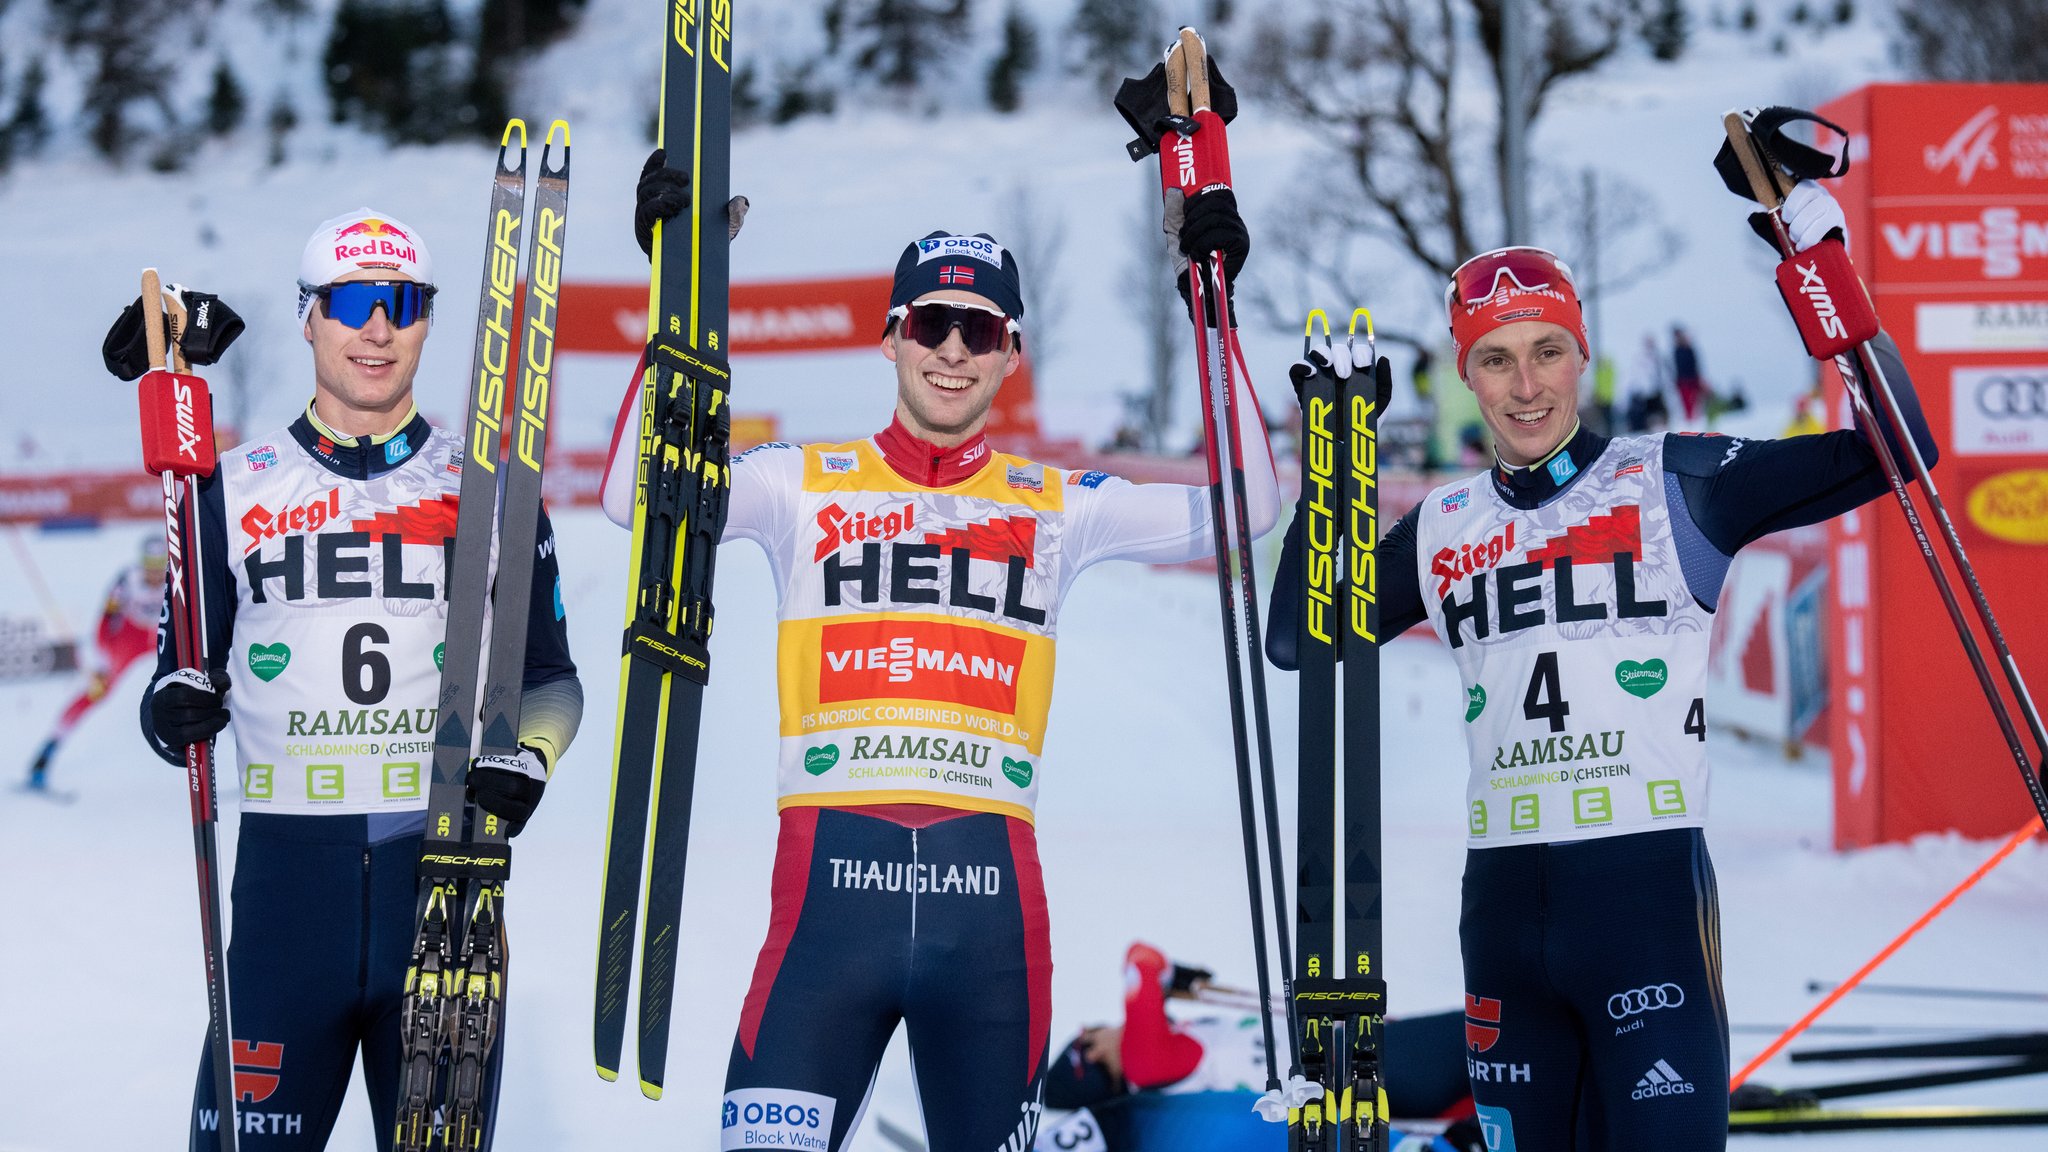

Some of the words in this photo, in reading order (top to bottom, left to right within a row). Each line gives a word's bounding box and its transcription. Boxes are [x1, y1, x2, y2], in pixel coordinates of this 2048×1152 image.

[335, 240, 377, 261] Red
[380, 241, 416, 264] Bull
[944, 239, 993, 254] OBOS
[973, 250, 1000, 267] Watne
[517, 207, 565, 473] FISCHER
[670, 316, 680, 335] 3D
[708, 331, 719, 351] 3D
[473, 208, 521, 475] FISCHER
[657, 344, 729, 380] FISCHER
[241, 487, 340, 555] Stiegl
[1308, 396, 1334, 645] FISCHER
[1351, 395, 1376, 644] FISCHER
[1891, 475, 1910, 506] TRIAC
[1914, 526, 1932, 557] AERO
[814, 502, 915, 563] Stiegl
[1431, 520, 1516, 600] Stiegl
[823, 543, 1046, 625] HELL
[1441, 551, 1667, 649] HELL
[251, 652, 287, 666] Steiermark
[341, 622, 391, 705] 6
[635, 635, 706, 671] FISCHER
[826, 637, 1015, 687] VIESSMANN
[1620, 669, 1664, 683] Steiermark
[1523, 651, 1570, 733] 4
[286, 709, 438, 737] RAMSAU
[802, 713, 815, 728] FIS
[819, 708, 871, 724] NORDIC
[875, 706, 962, 724] COMBINED
[965, 713, 1015, 737] WORLD
[1684, 697, 1706, 742] 4
[850, 735, 991, 768] RAMSAU
[1491, 730, 1625, 771] RAMSAU
[437, 816, 450, 837] 3D
[485, 814, 497, 836] 3D
[421, 854, 506, 867] FISCHER
[829, 858, 1000, 896] THAUGLAND
[1308, 957, 1320, 978] 3D
[1358, 954, 1370, 976] 3D
[1296, 992, 1380, 1000] FISCHER
[1615, 1019, 1645, 1036] Audi
[1467, 1057, 1531, 1082] ÜRTH
[1631, 1082, 1695, 1100] adidas
[744, 1102, 820, 1130] OBOS
[745, 1130, 785, 1145] Block
[789, 1131, 827, 1151] Watne
